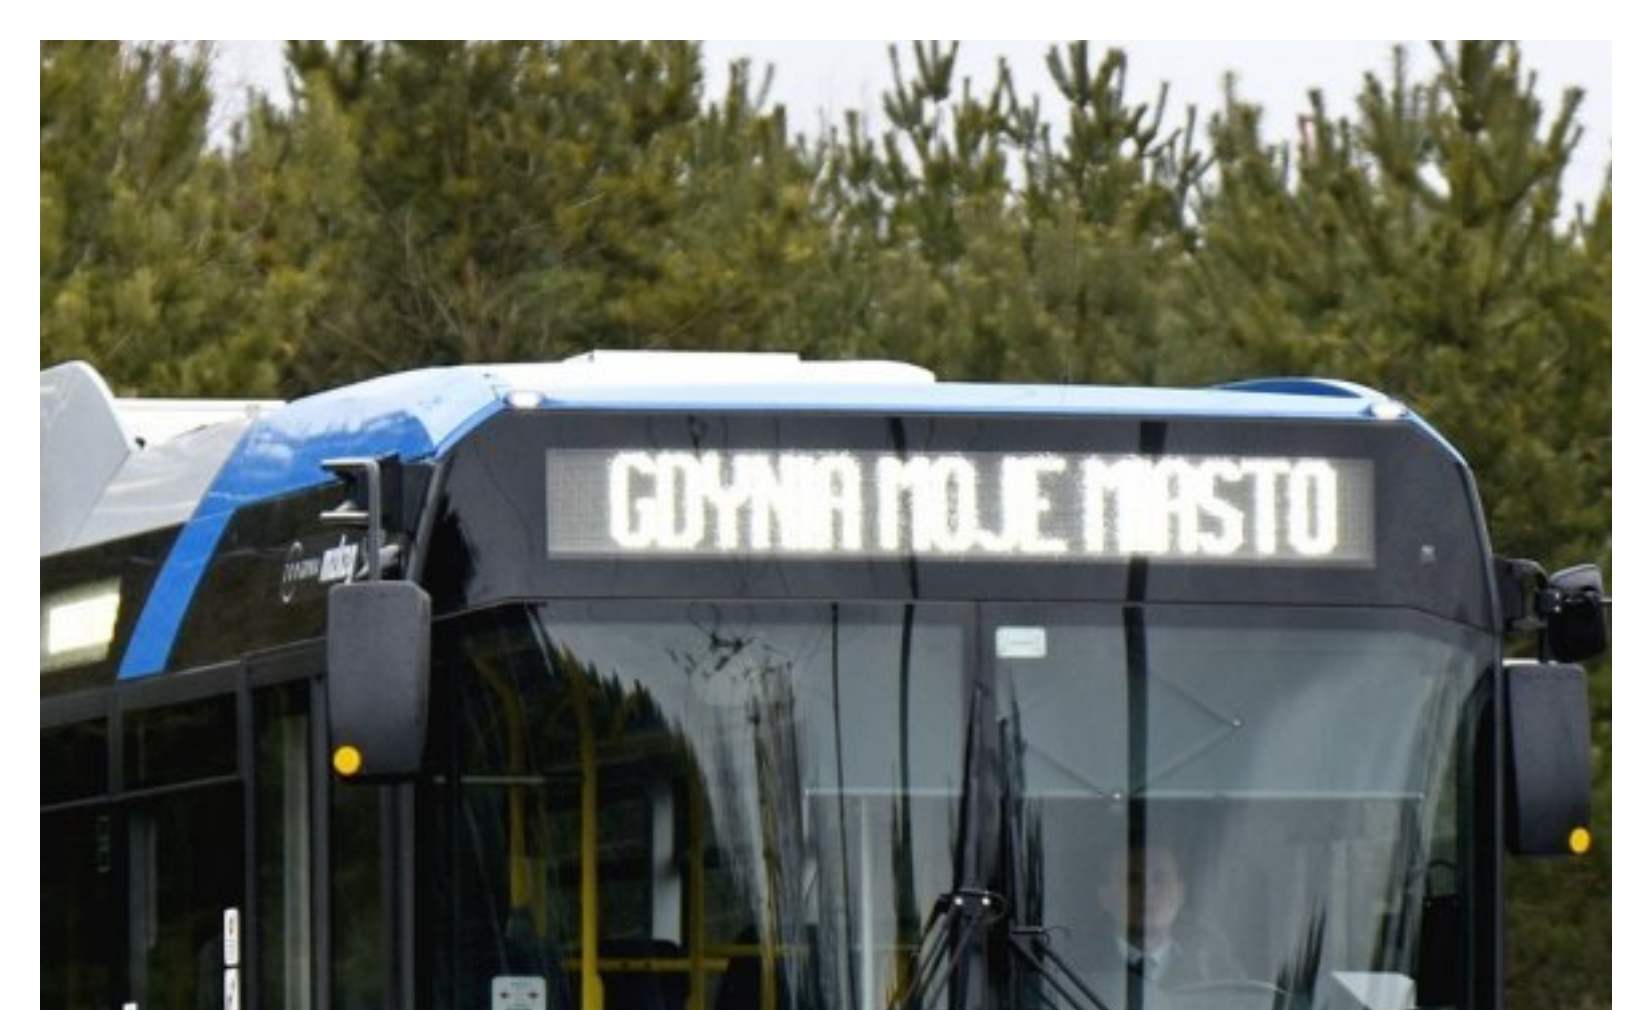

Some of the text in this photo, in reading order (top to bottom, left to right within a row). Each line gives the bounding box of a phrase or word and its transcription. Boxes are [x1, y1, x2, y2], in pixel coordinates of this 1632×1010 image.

[608, 450, 1338, 556] GDYNIA MOJE MIASTO
